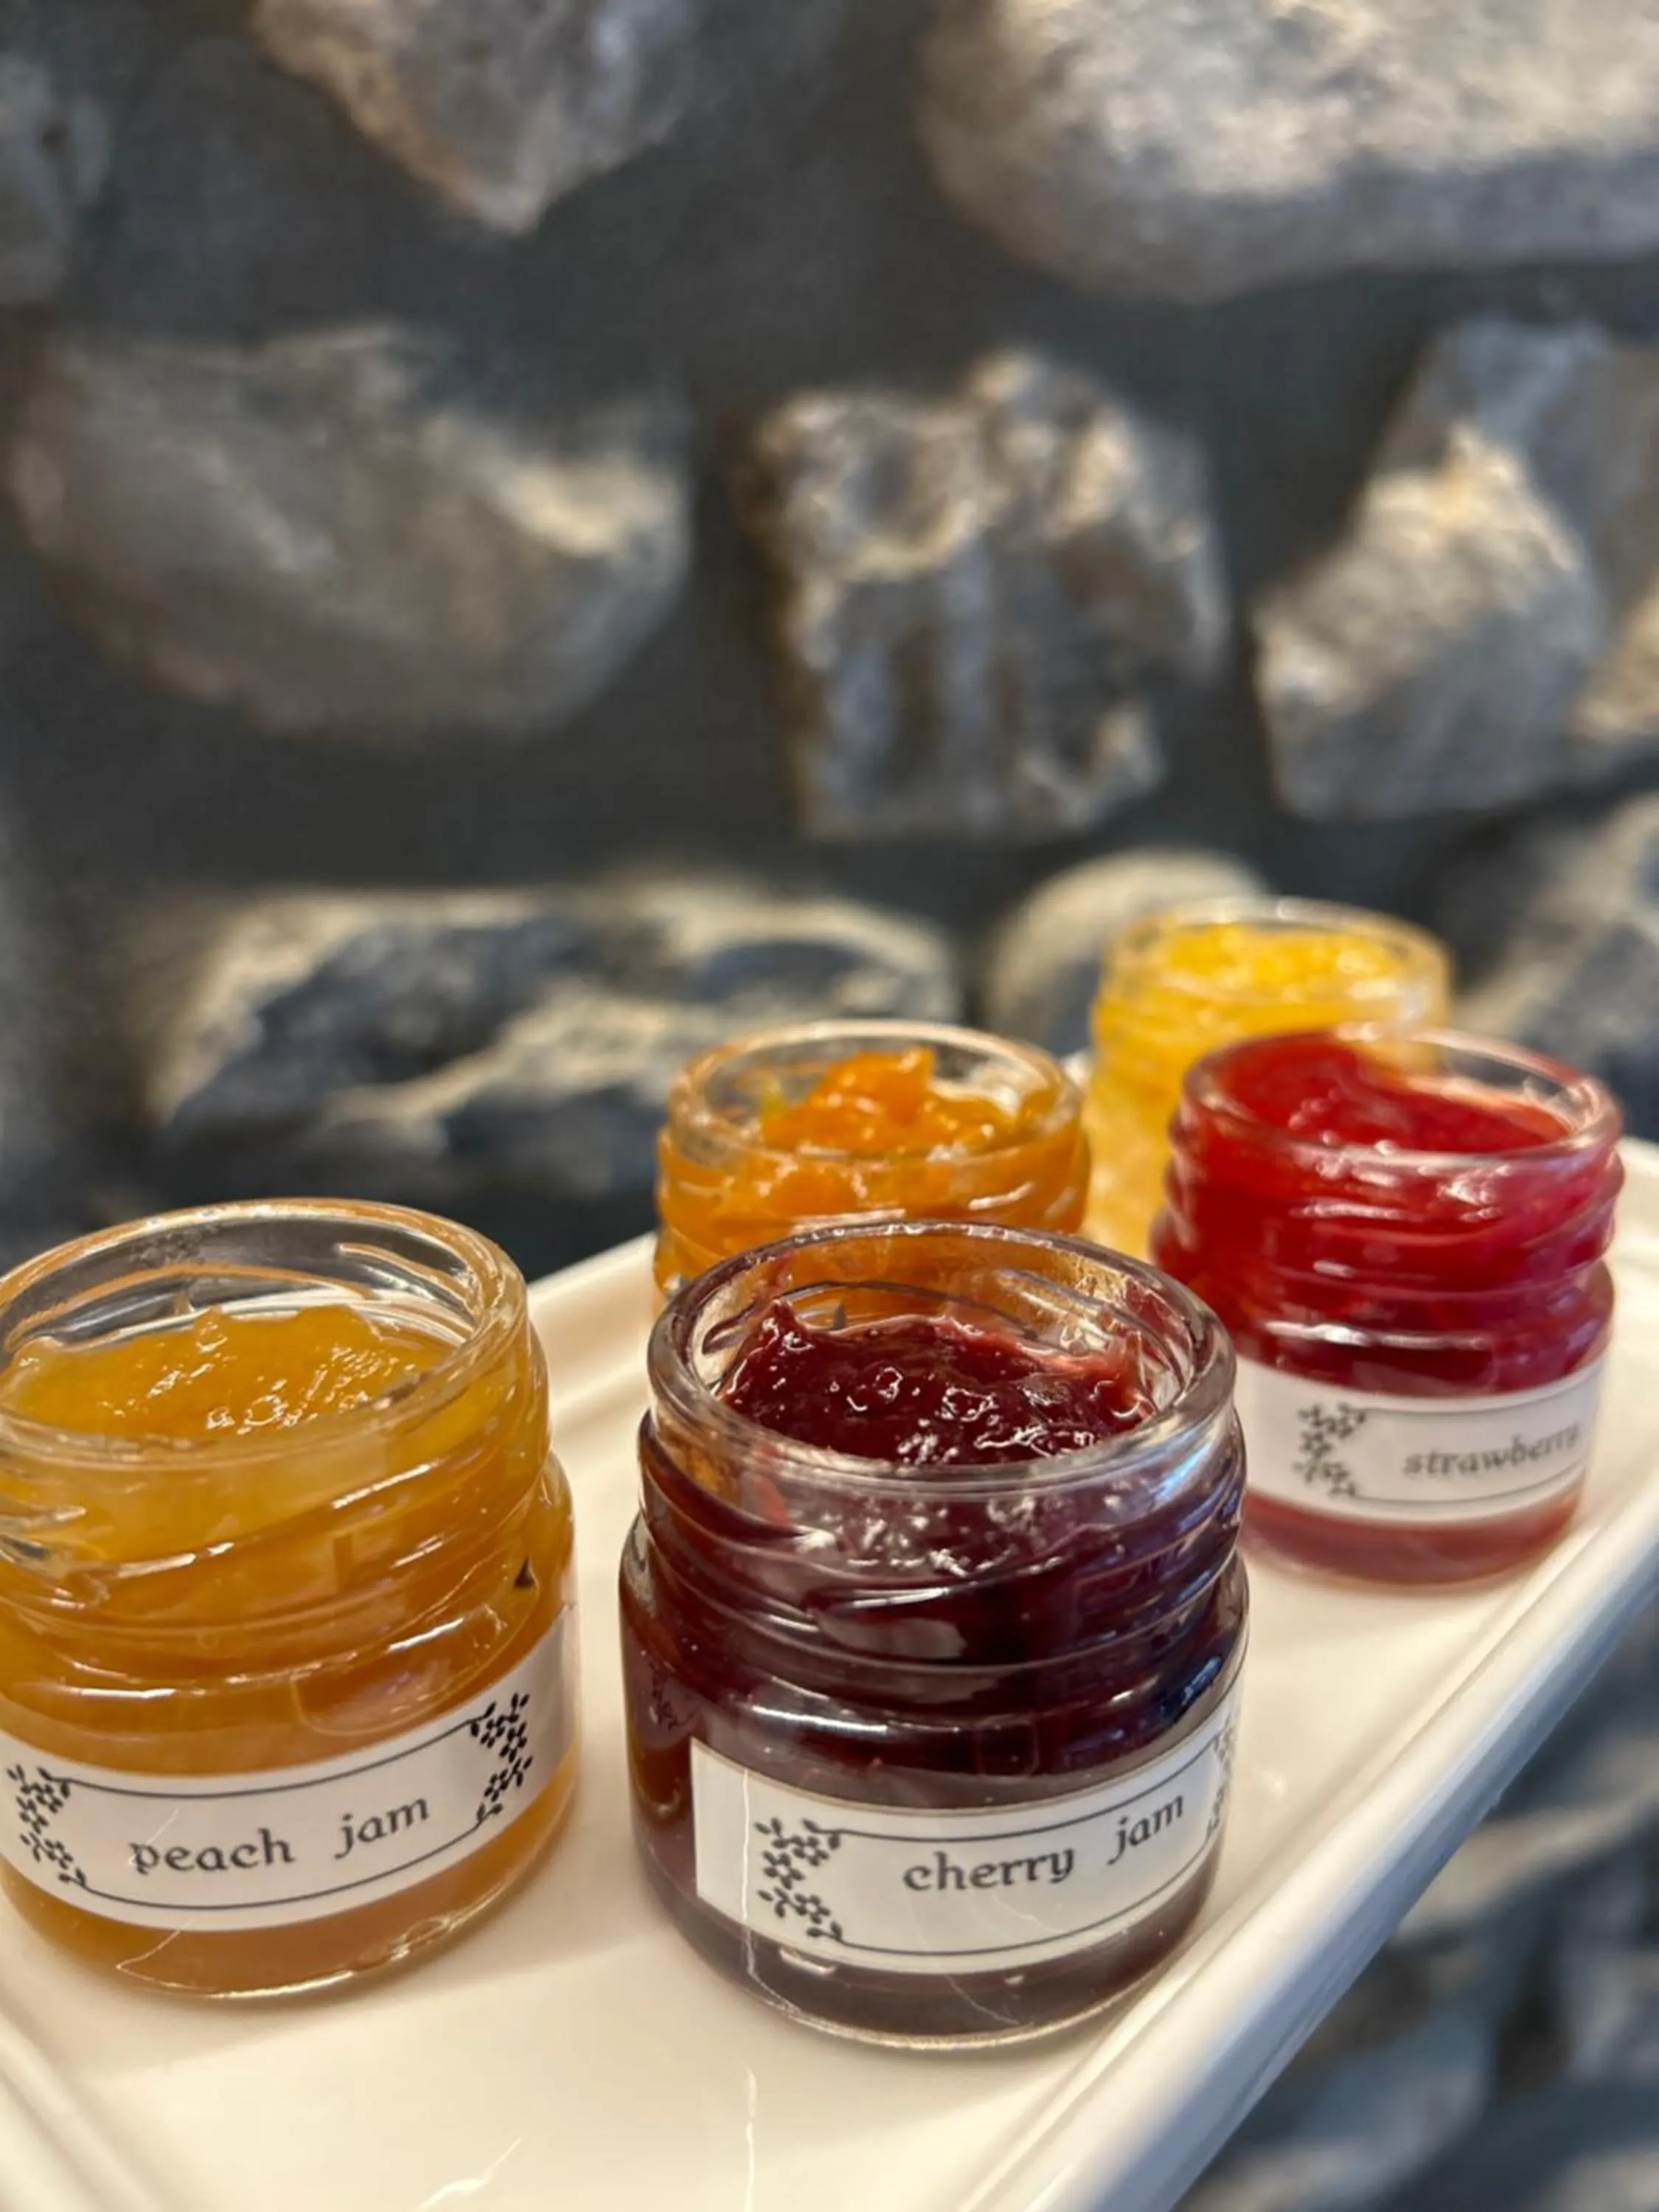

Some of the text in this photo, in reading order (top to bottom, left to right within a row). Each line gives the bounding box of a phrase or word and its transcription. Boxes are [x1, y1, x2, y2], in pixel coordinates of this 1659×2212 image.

[1403, 1422, 1580, 1475] strawberry
[129, 1798, 430, 1874] peach jam
[903, 1795, 1185, 1891] cherry jam
